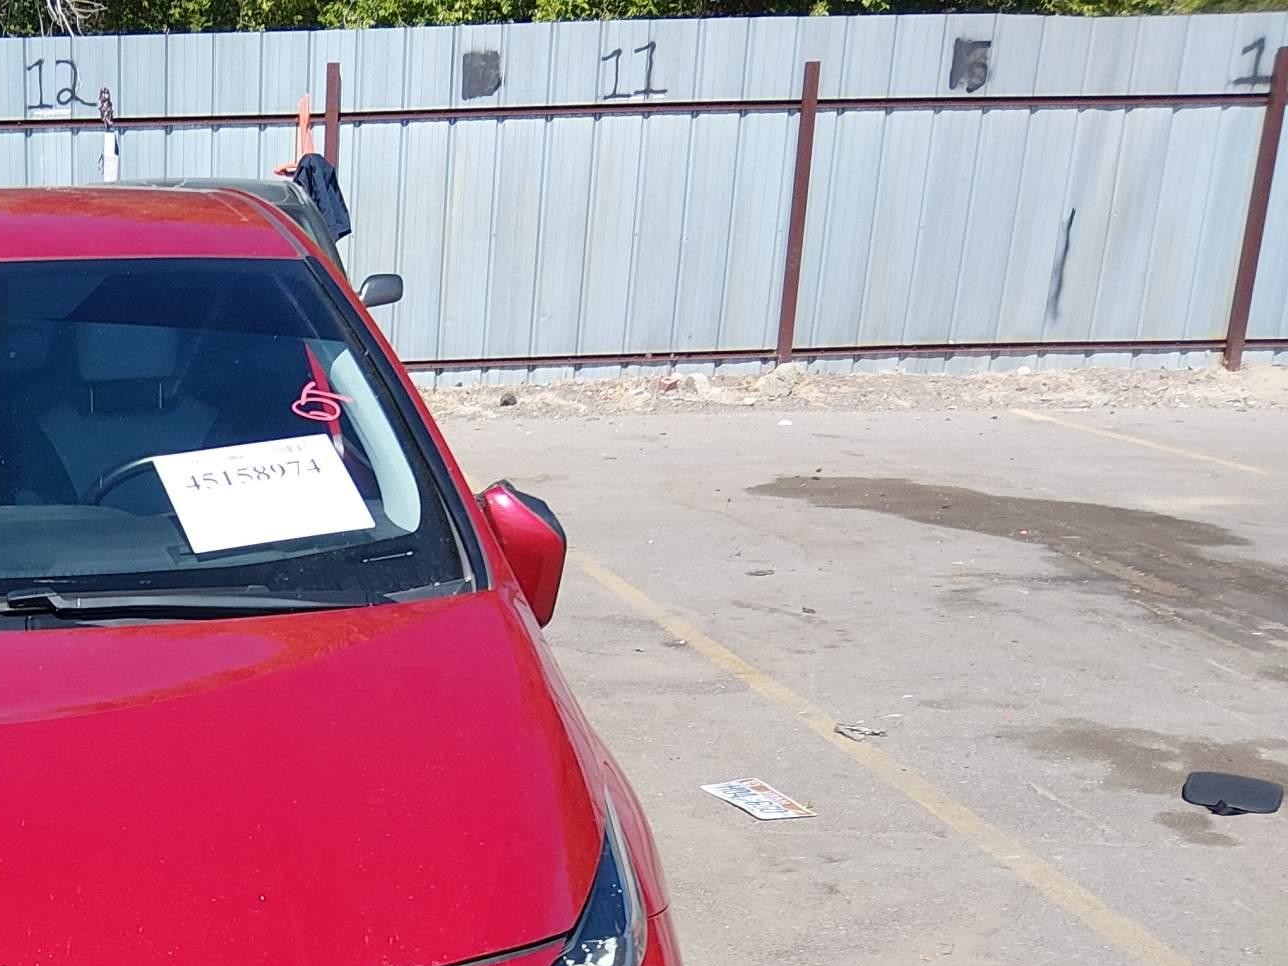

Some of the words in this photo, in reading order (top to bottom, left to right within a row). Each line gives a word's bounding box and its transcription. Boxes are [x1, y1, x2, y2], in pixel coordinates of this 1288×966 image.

[27, 58, 98, 109] 12
[601, 41, 668, 100] 11
[186, 457, 321, 491] 45158974
